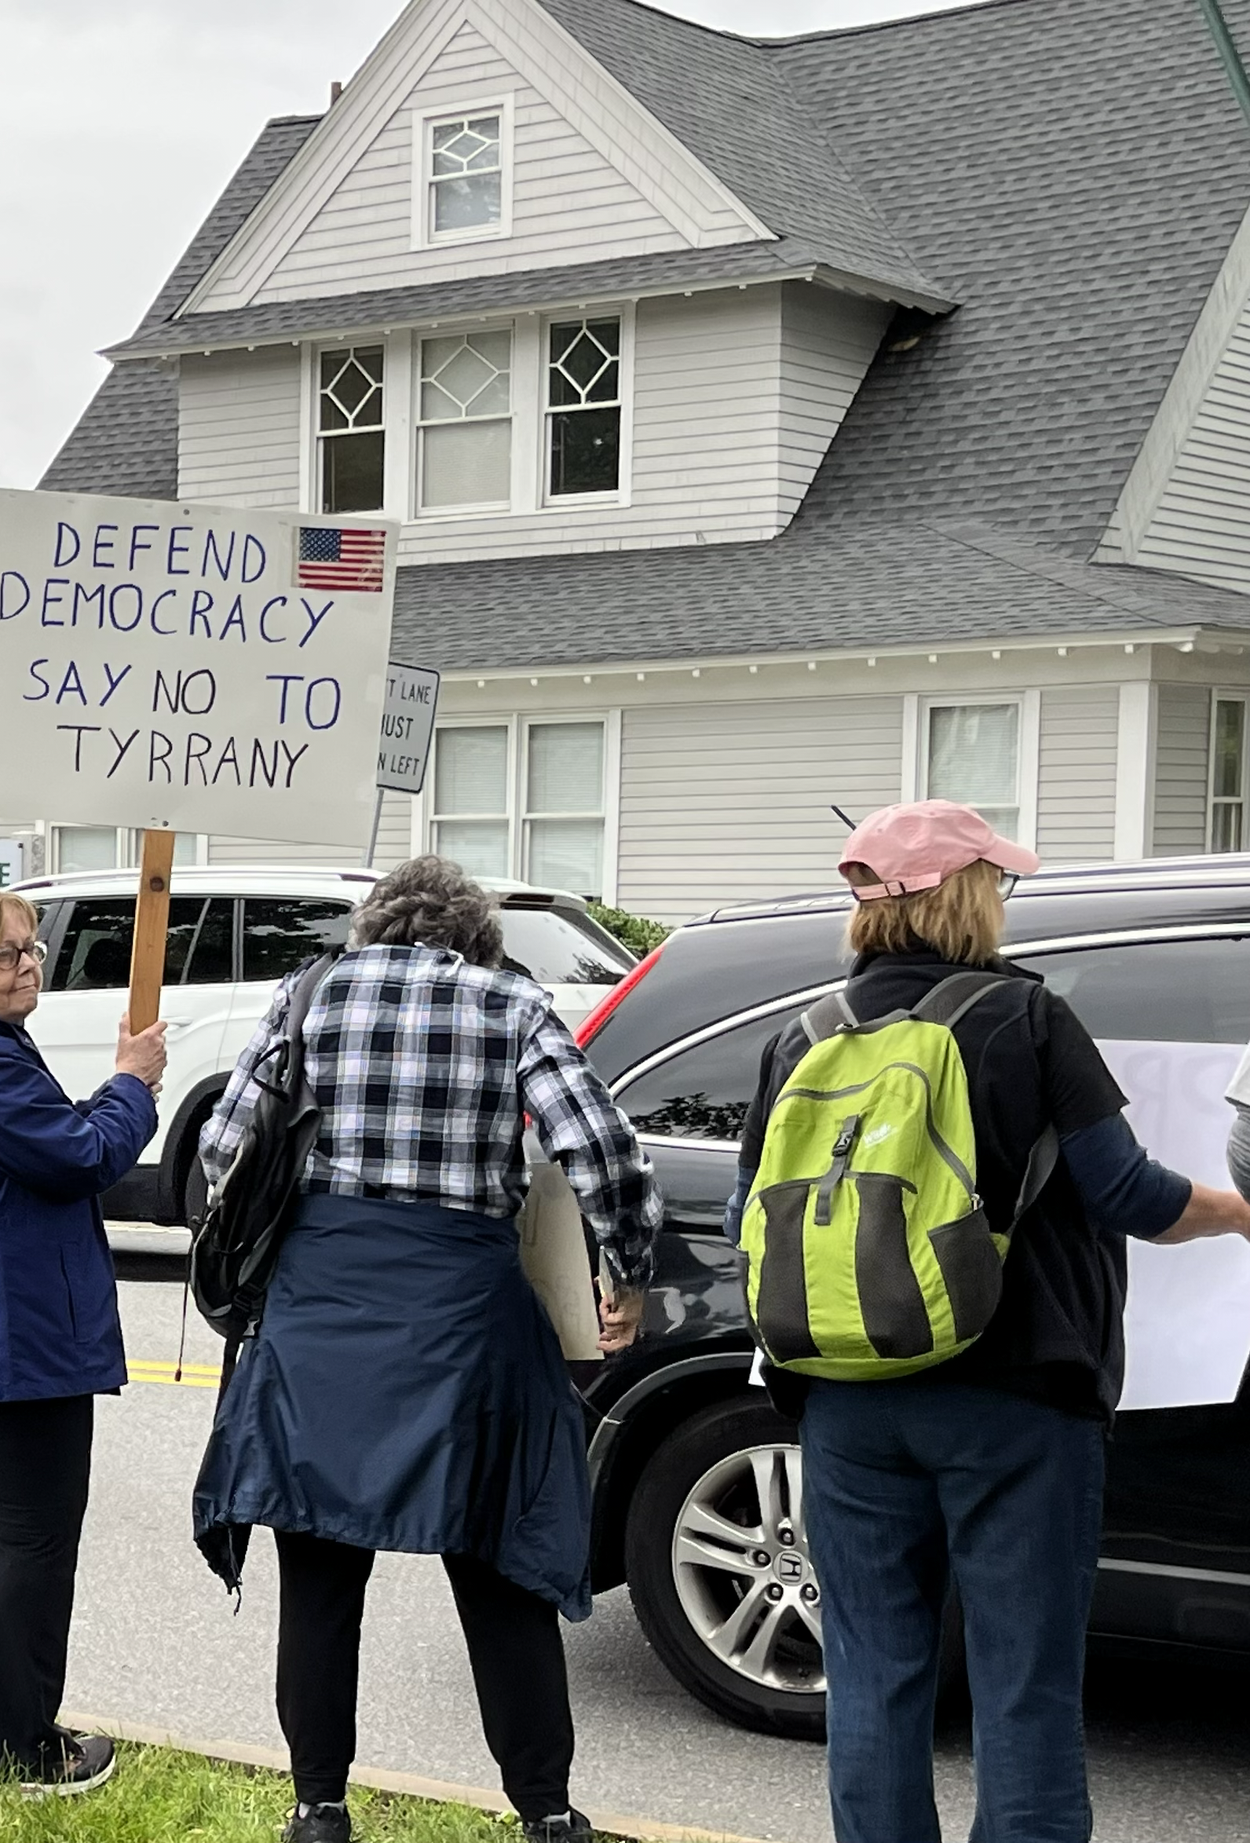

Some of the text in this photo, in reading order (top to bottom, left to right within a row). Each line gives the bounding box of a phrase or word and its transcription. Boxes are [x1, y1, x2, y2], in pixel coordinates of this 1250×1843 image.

[53, 522, 266, 583] DEFEND
[0, 572, 333, 647] DEMOCRACY
[23, 659, 340, 730] SAY NO TO
[401, 682, 432, 705] LANE
[57, 725, 308, 788] TYRRANY
[390, 755, 420, 776] LEFT
